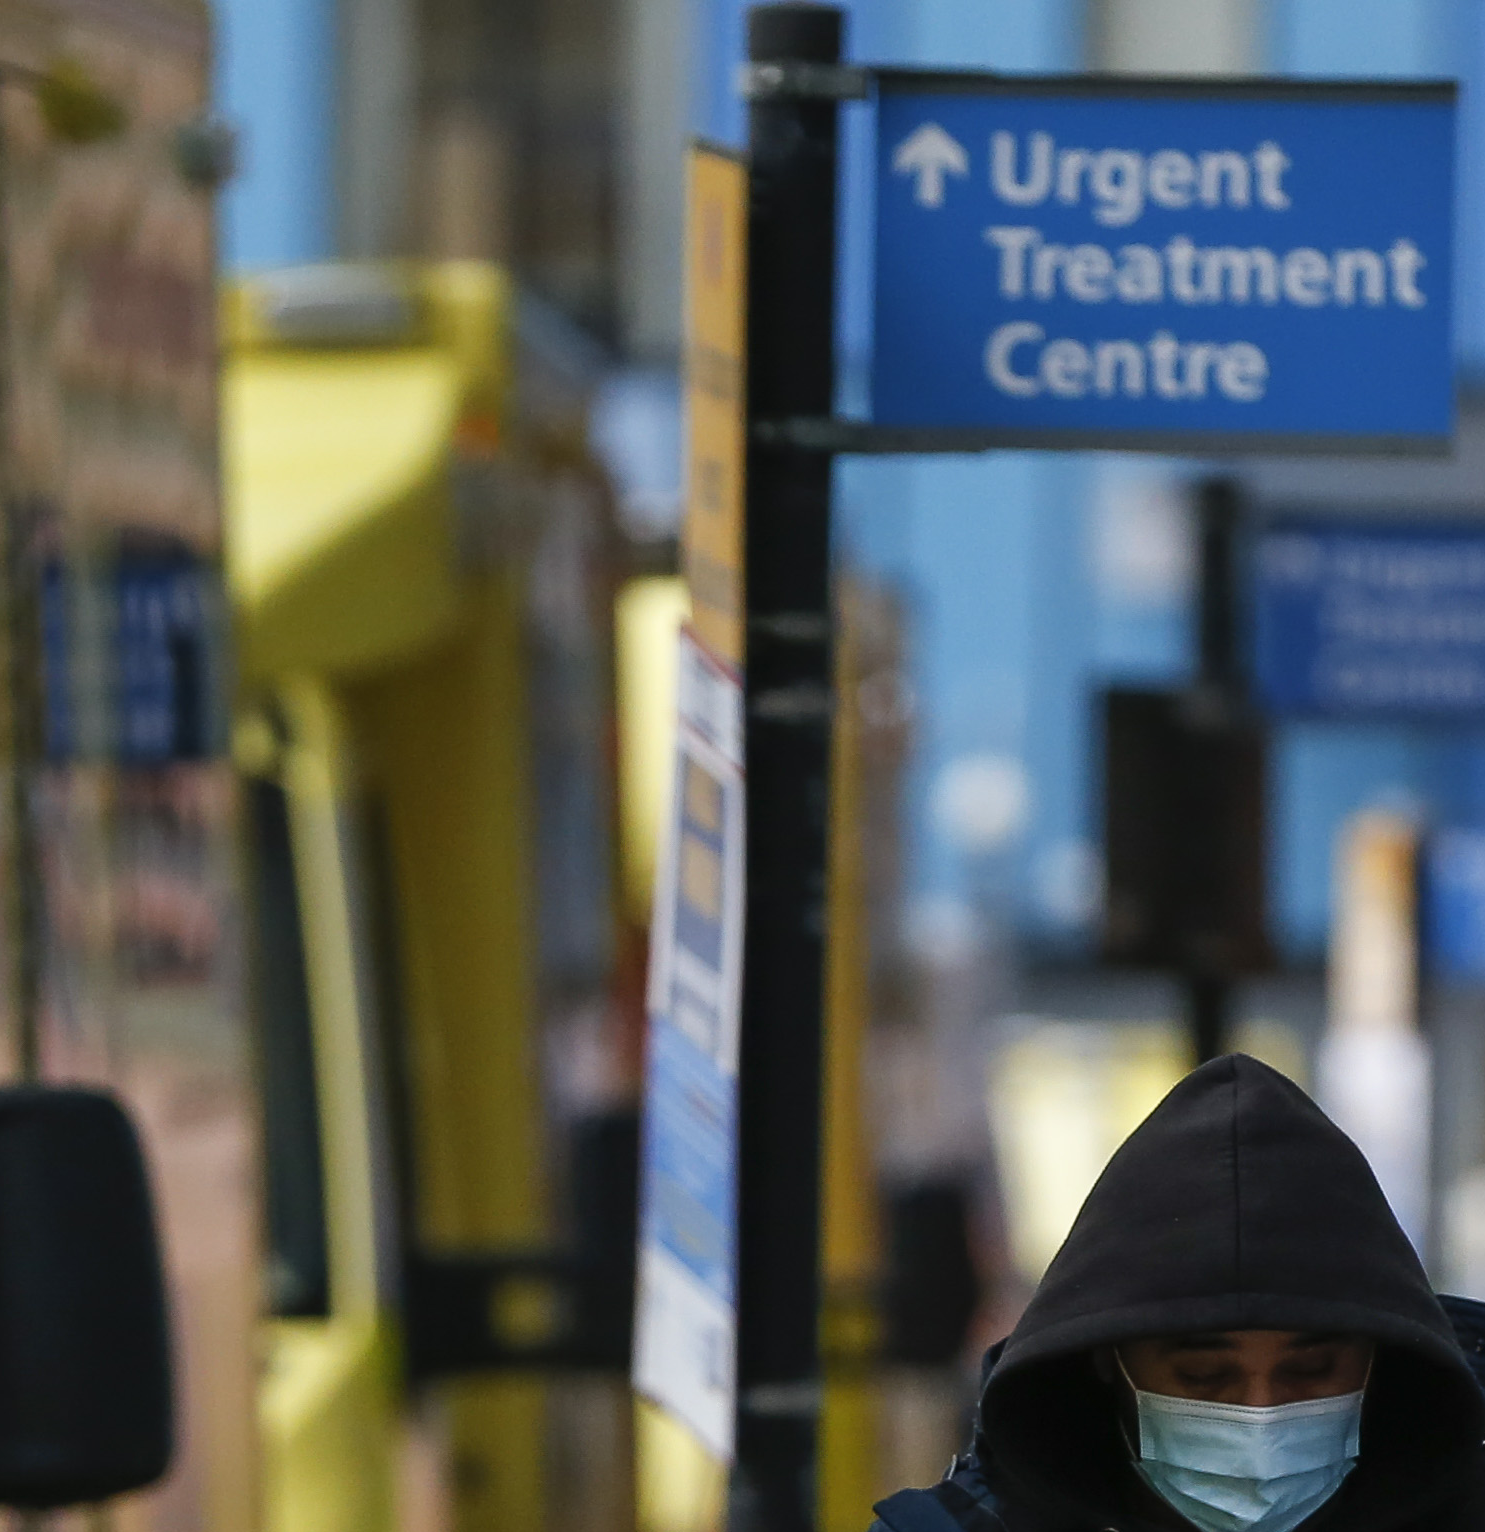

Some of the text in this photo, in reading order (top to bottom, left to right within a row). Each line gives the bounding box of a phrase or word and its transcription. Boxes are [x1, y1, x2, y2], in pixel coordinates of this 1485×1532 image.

[988, 130, 1292, 226] Urgent
[986, 226, 1426, 309] Treatment
[985, 321, 1269, 402] Centre
